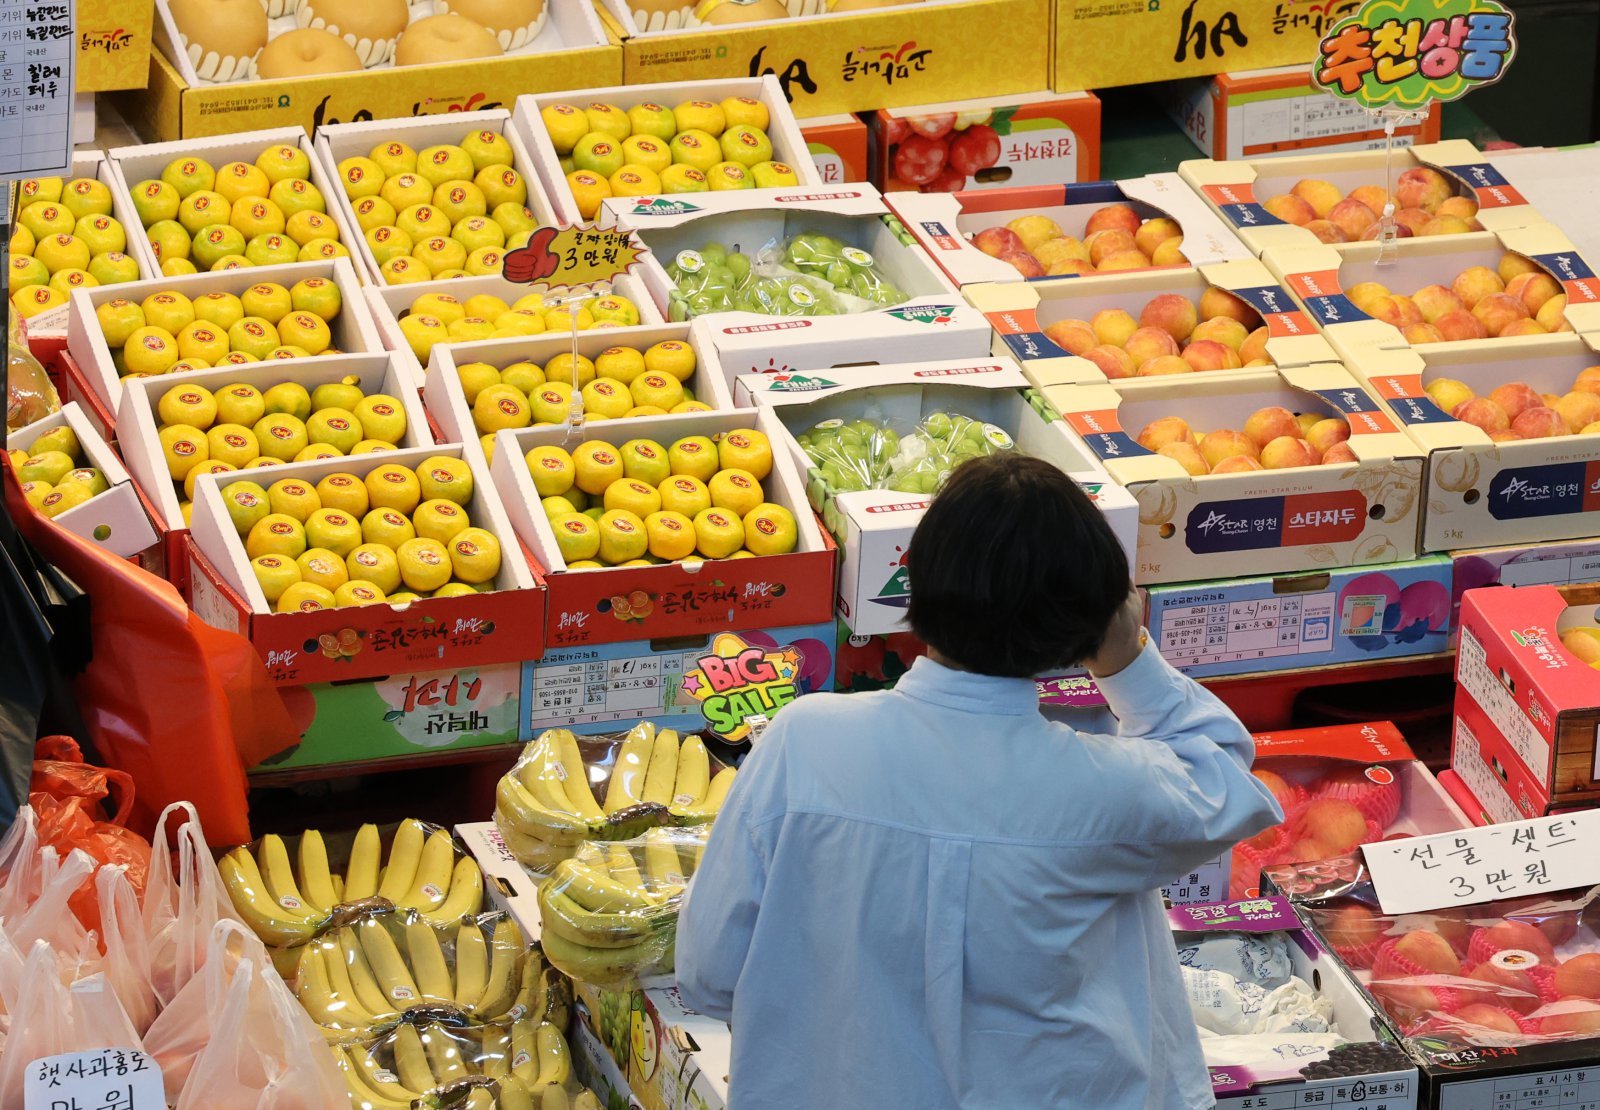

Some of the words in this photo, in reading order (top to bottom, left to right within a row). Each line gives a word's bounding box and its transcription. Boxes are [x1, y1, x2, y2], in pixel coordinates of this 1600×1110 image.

[842, 40, 932, 85] 고맛나루
[1319, 12, 1509, 94] 추천상품
[27, 81, 58, 99] 페루
[1006, 138, 1074, 162] 김천자두
[1555, 483, 1579, 498] 영천
[1253, 517, 1277, 533] 영천
[1288, 508, 1357, 529] 스타자두
[699, 649, 775, 693] BIG
[403, 675, 483, 713] 사과
[701, 685, 798, 734] SALE
[424, 711, 489, 734] 대덕산
[1481, 1047, 1518, 1058] 사과
[1241, 1097, 1268, 1109] 포도
[1304, 1091, 1325, 1104] 등급
